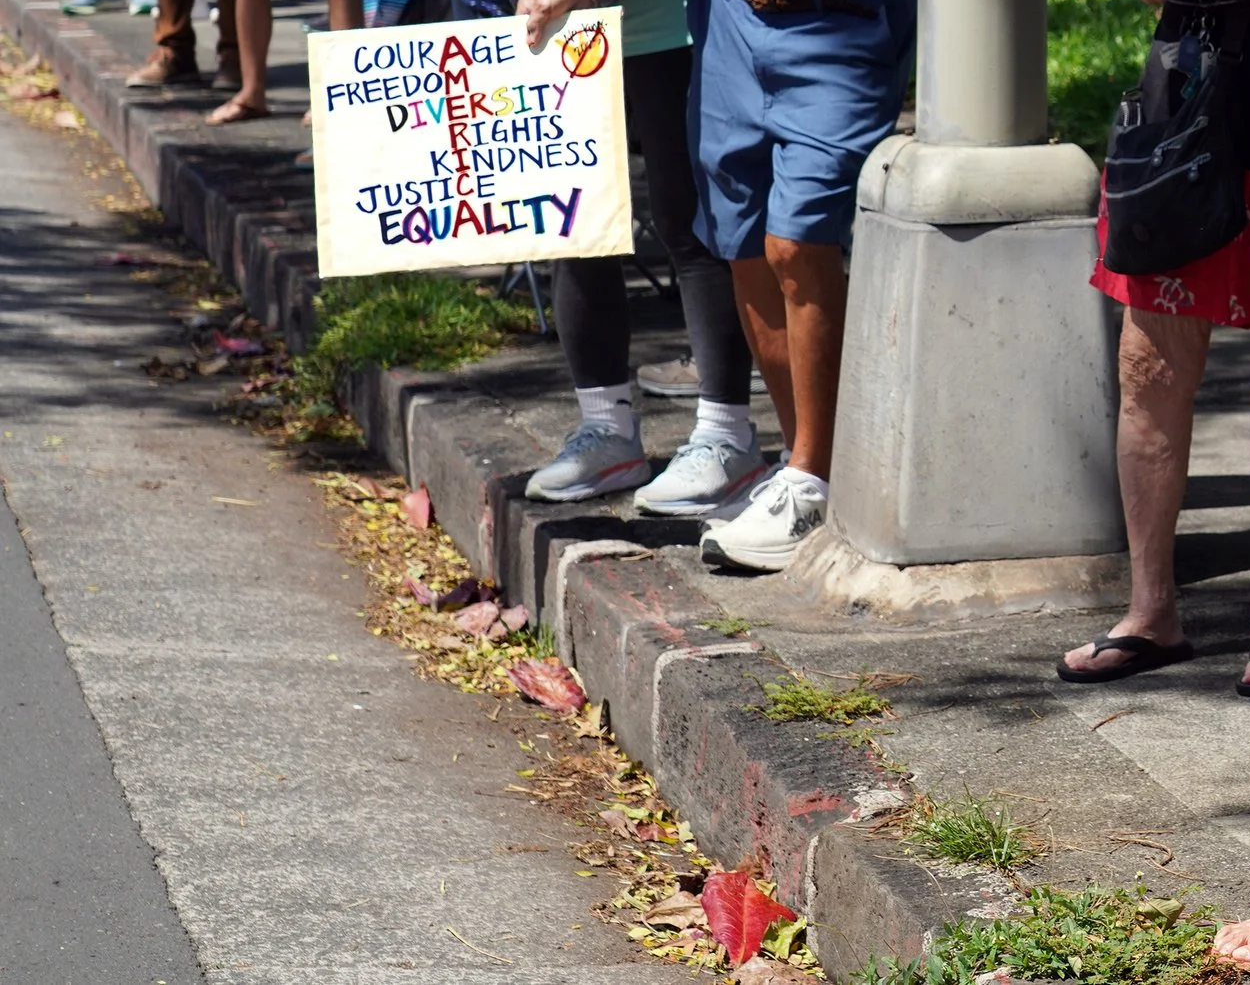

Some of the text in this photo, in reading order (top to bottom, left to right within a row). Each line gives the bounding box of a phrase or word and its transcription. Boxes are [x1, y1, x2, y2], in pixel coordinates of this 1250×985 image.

[353, 34, 516, 74] COURAGE
[326, 67, 471, 112] FREEDOM
[386, 80, 570, 133] DIVERSITY
[448, 114, 565, 150] RIGHTS
[429, 138, 599, 177] KINDNESS
[355, 171, 497, 215] JUSTICE
[378, 187, 583, 246] EQUALITY
